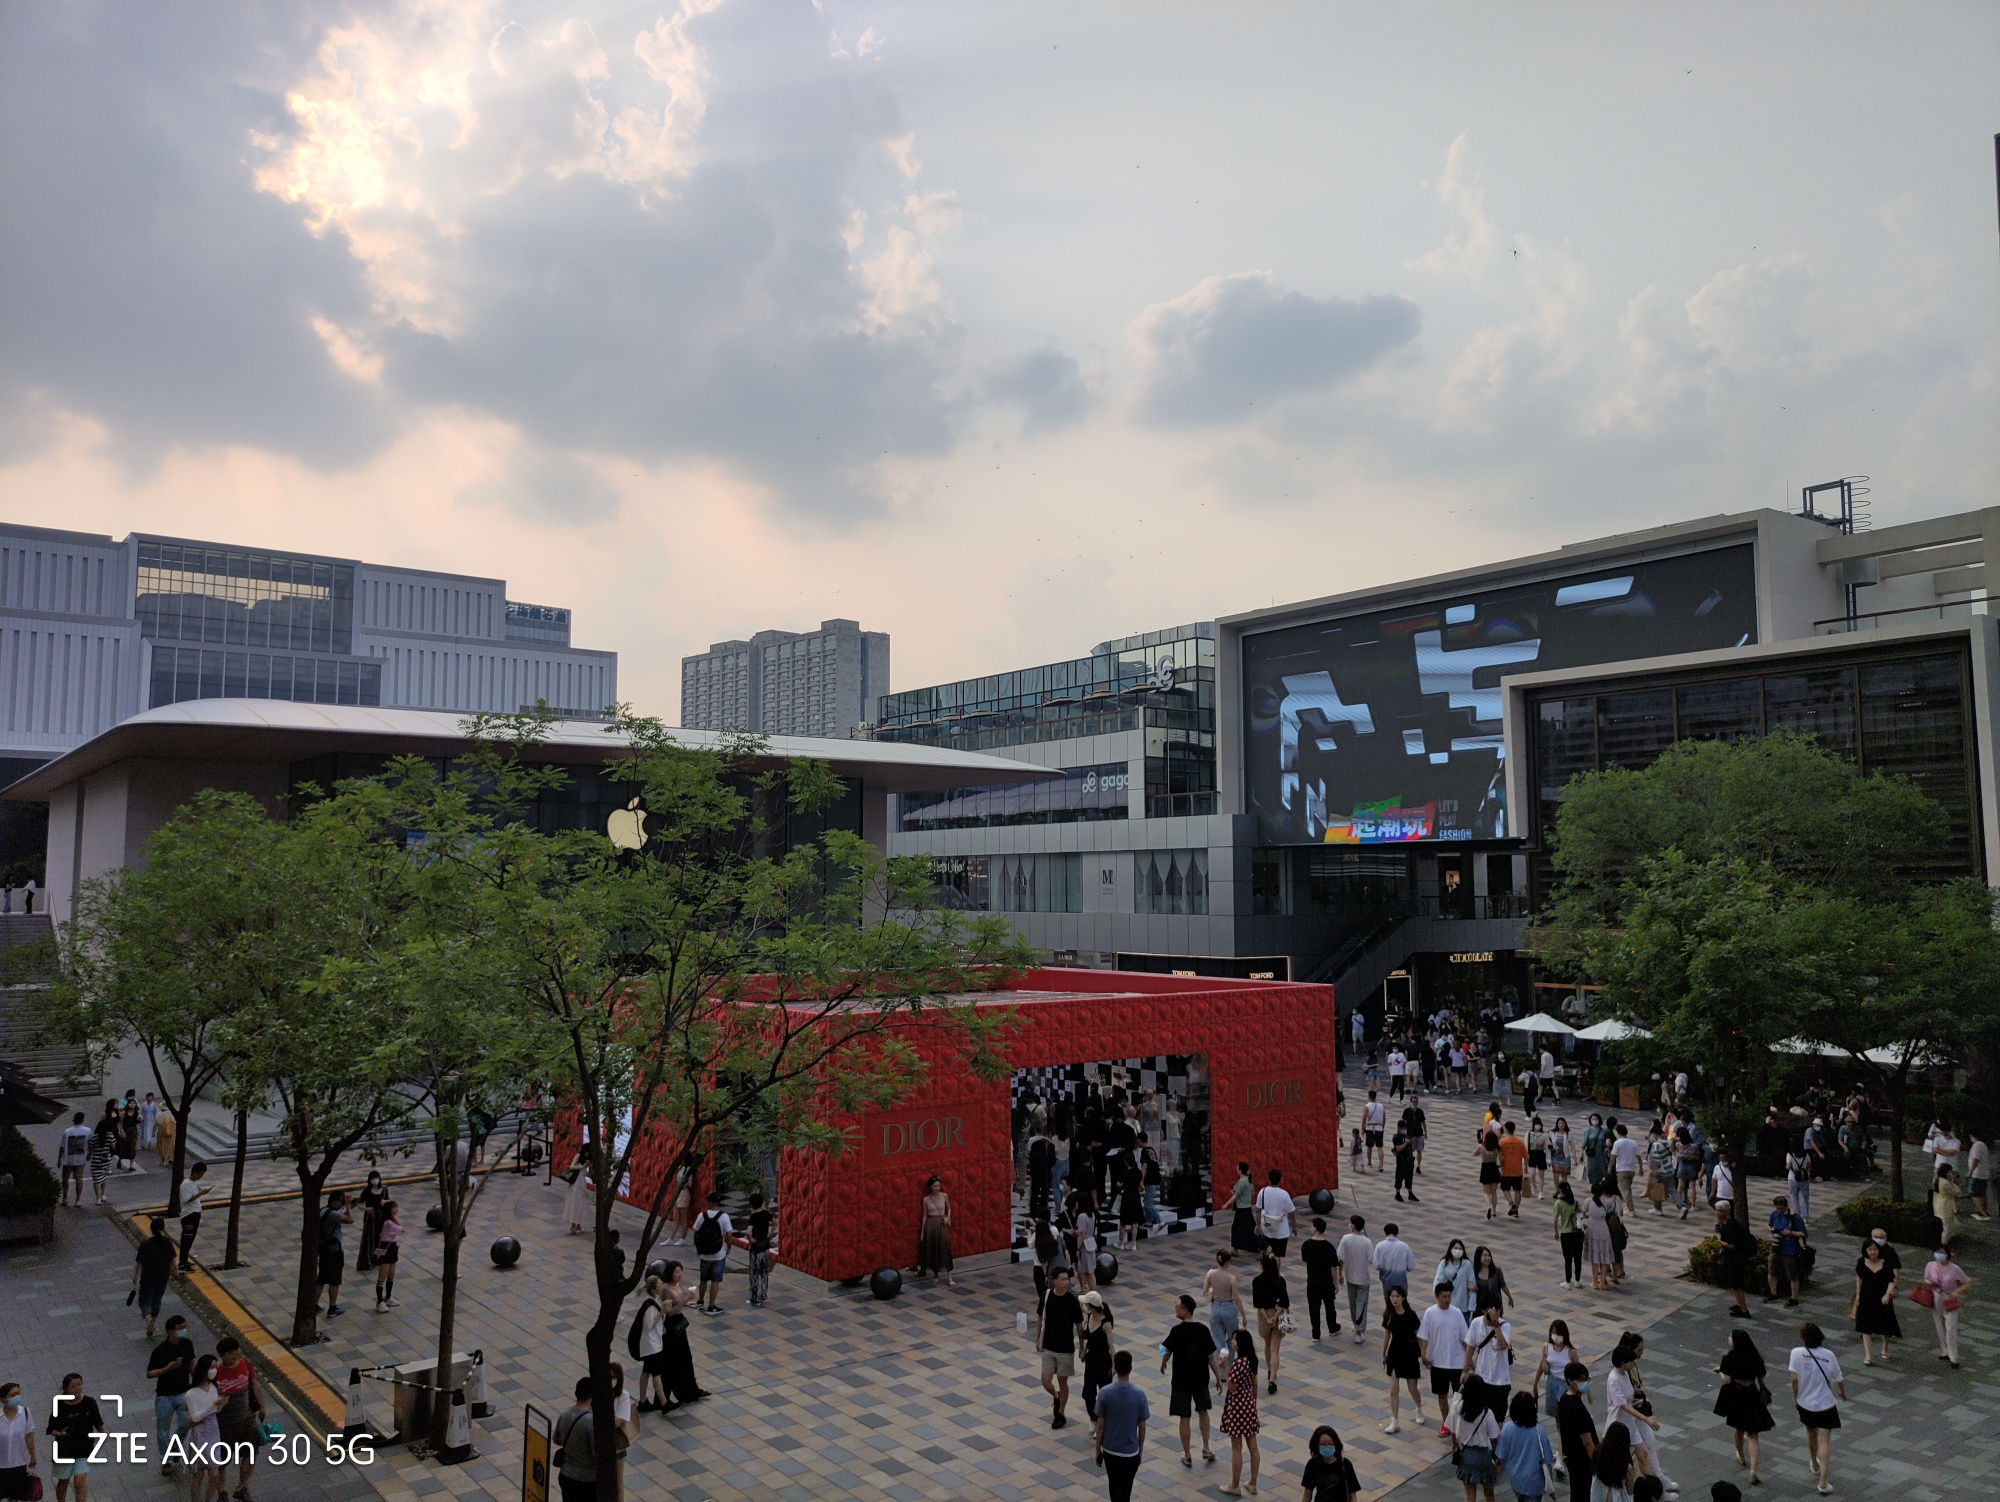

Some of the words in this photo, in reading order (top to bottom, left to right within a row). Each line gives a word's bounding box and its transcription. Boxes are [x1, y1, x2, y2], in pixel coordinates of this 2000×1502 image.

[1102, 869, 1114, 884] M
[1246, 1077, 1304, 1110] DIOR
[880, 1116, 967, 1156] DIOR
